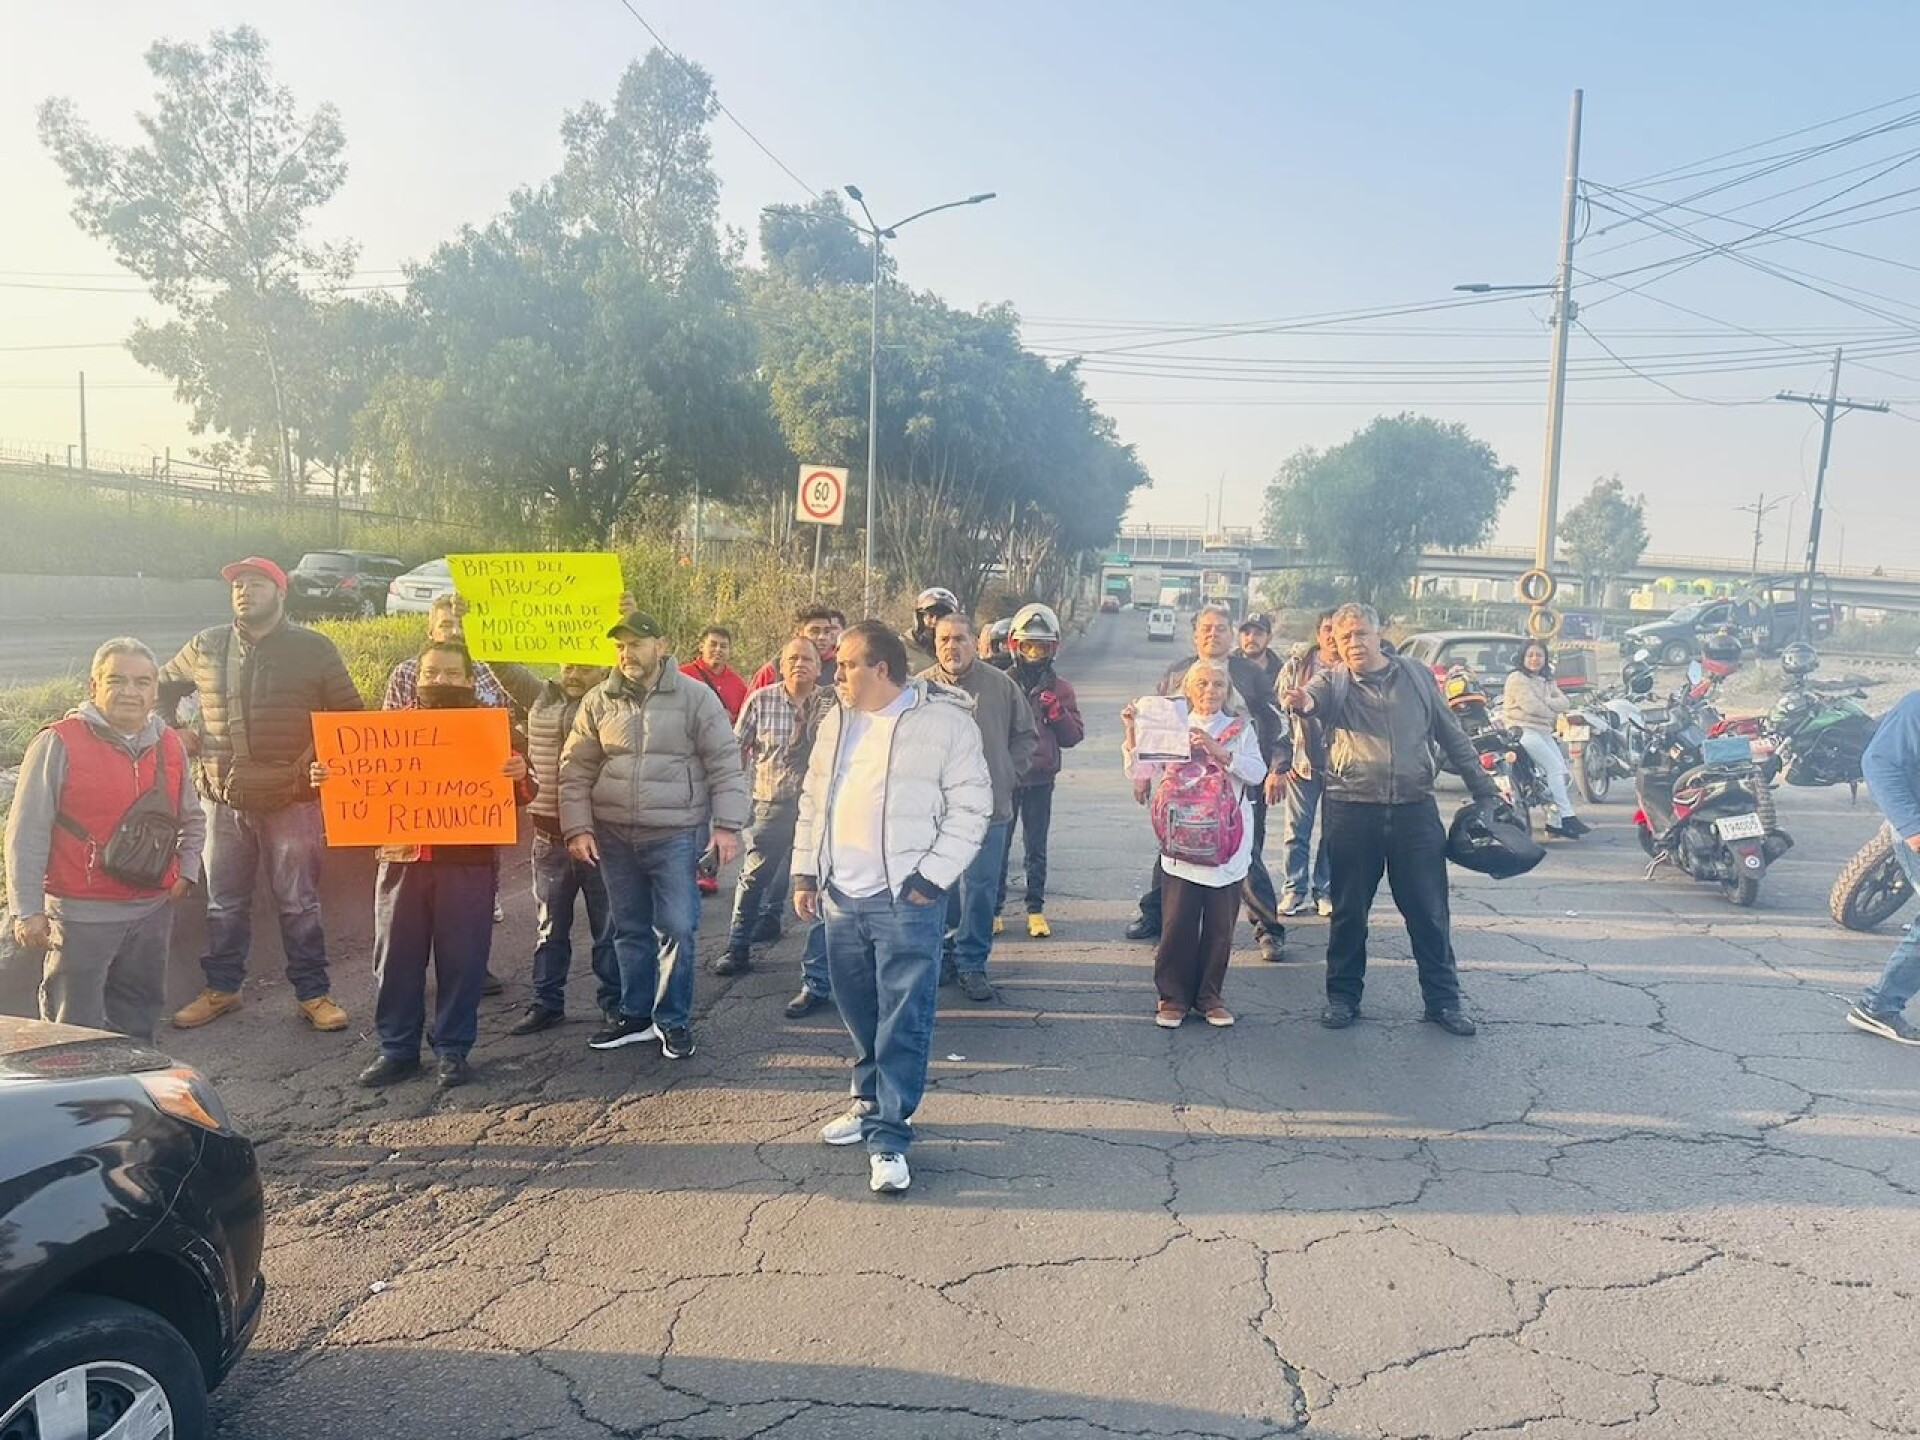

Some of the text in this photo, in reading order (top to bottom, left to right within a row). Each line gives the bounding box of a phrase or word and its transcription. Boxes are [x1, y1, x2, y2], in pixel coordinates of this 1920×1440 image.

[814, 481, 830, 501] 60
[537, 560, 562, 572] DEL
[510, 599, 572, 617] CONTRA
[581, 605, 600, 616] DE
[481, 618, 536, 636] MOTOS
[514, 635, 547, 651] EDO
[559, 635, 600, 651] MEX
[336, 725, 452, 755] DANIEL
[327, 757, 421, 776] SIBAJA
